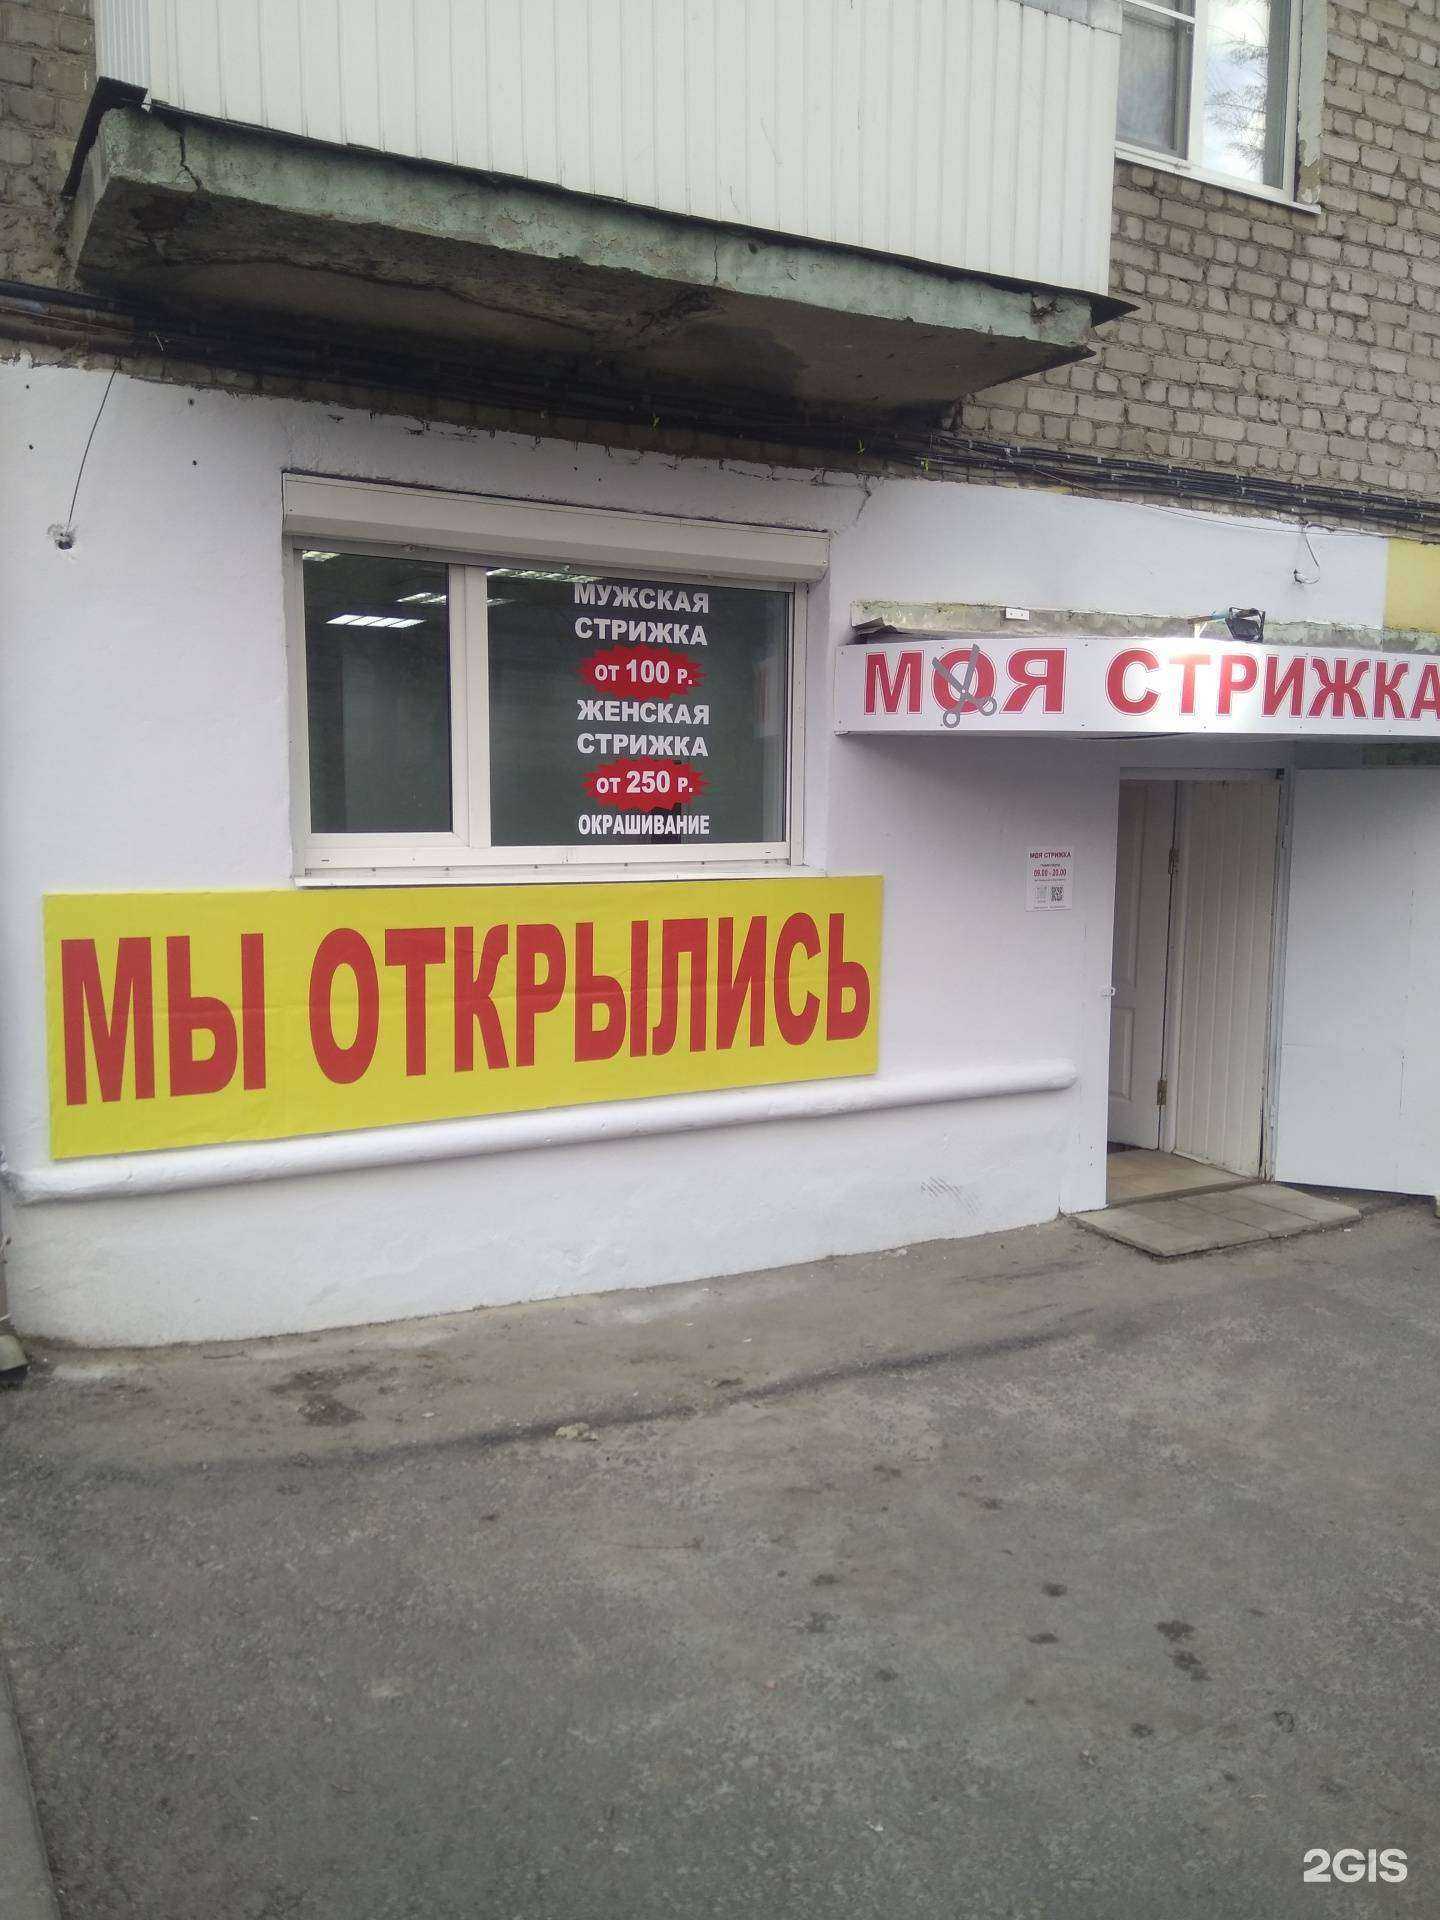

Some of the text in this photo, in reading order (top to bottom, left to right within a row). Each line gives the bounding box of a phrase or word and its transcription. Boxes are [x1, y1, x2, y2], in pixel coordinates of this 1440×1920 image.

[574, 583, 709, 613] МУЖСКАЯ
[574, 617, 708, 645] СТРИЖКА
[626, 660, 670, 684] 100
[863, 647, 1440, 719] МОЯ СТРИЖКА
[577, 700, 710, 725] ЖЕНСКАЯ
[577, 733, 709, 757] СТРИЖКА
[626, 770, 670, 794] 250
[578, 814, 710, 835] ОКРАШИВАНИЕ
[60, 912, 871, 1106] МЫ ОТКРЫЛИСЬ
